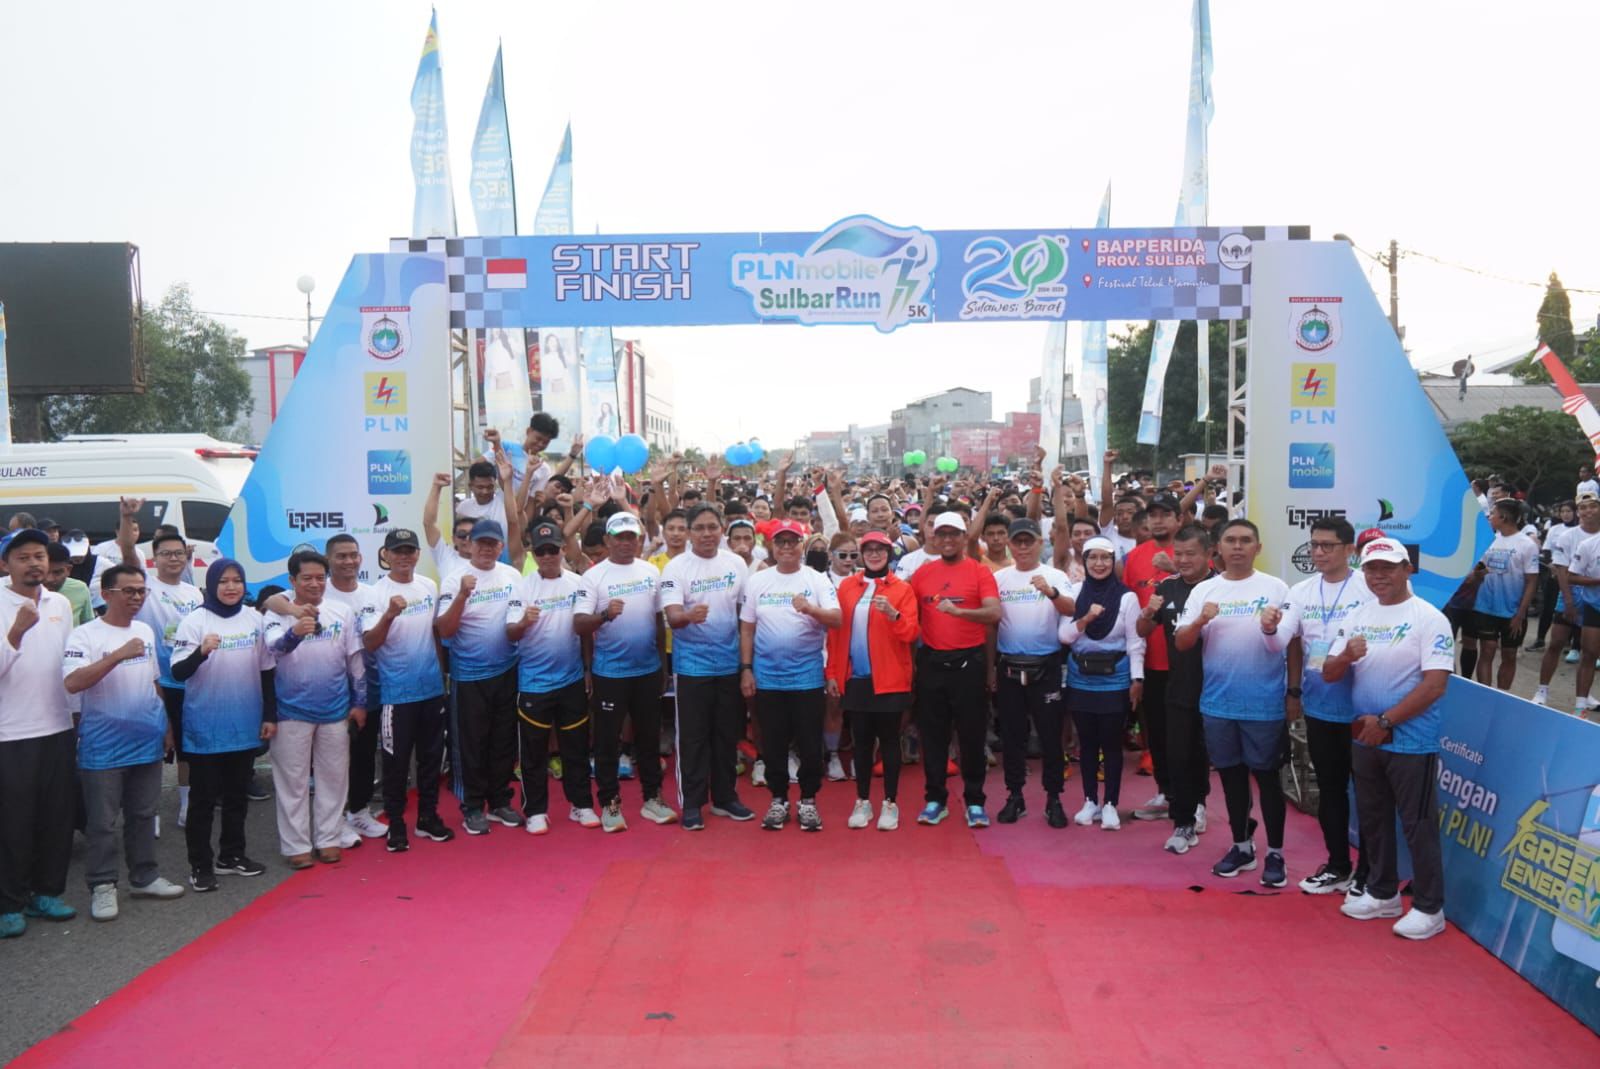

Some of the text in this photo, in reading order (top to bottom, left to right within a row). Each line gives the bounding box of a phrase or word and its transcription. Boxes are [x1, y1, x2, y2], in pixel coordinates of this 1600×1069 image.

[1097, 238, 1205, 253] BAPPERIDA
[552, 242, 700, 272] START
[1097, 254, 1206, 267] PROV. SULBAR
[555, 272, 692, 301] FINISH
[1098, 276, 1137, 289] Festival
[1140, 275, 1164, 288] Teluk
[759, 286, 881, 309] SulbarRun
[908, 305, 928, 318] 5K
[963, 300, 1062, 315] Sulawesi Barat
[365, 416, 408, 432] PLN
[1290, 409, 1335, 424] PLN
[370, 463, 392, 472] PLN
[1292, 456, 1315, 465] PLN
[370, 472, 409, 483] mobile
[1292, 466, 1333, 477] mobile
[288, 511, 344, 532] QRIS
[1446, 809, 1493, 857] PLN!
[1510, 858, 1600, 918] ENERGY
